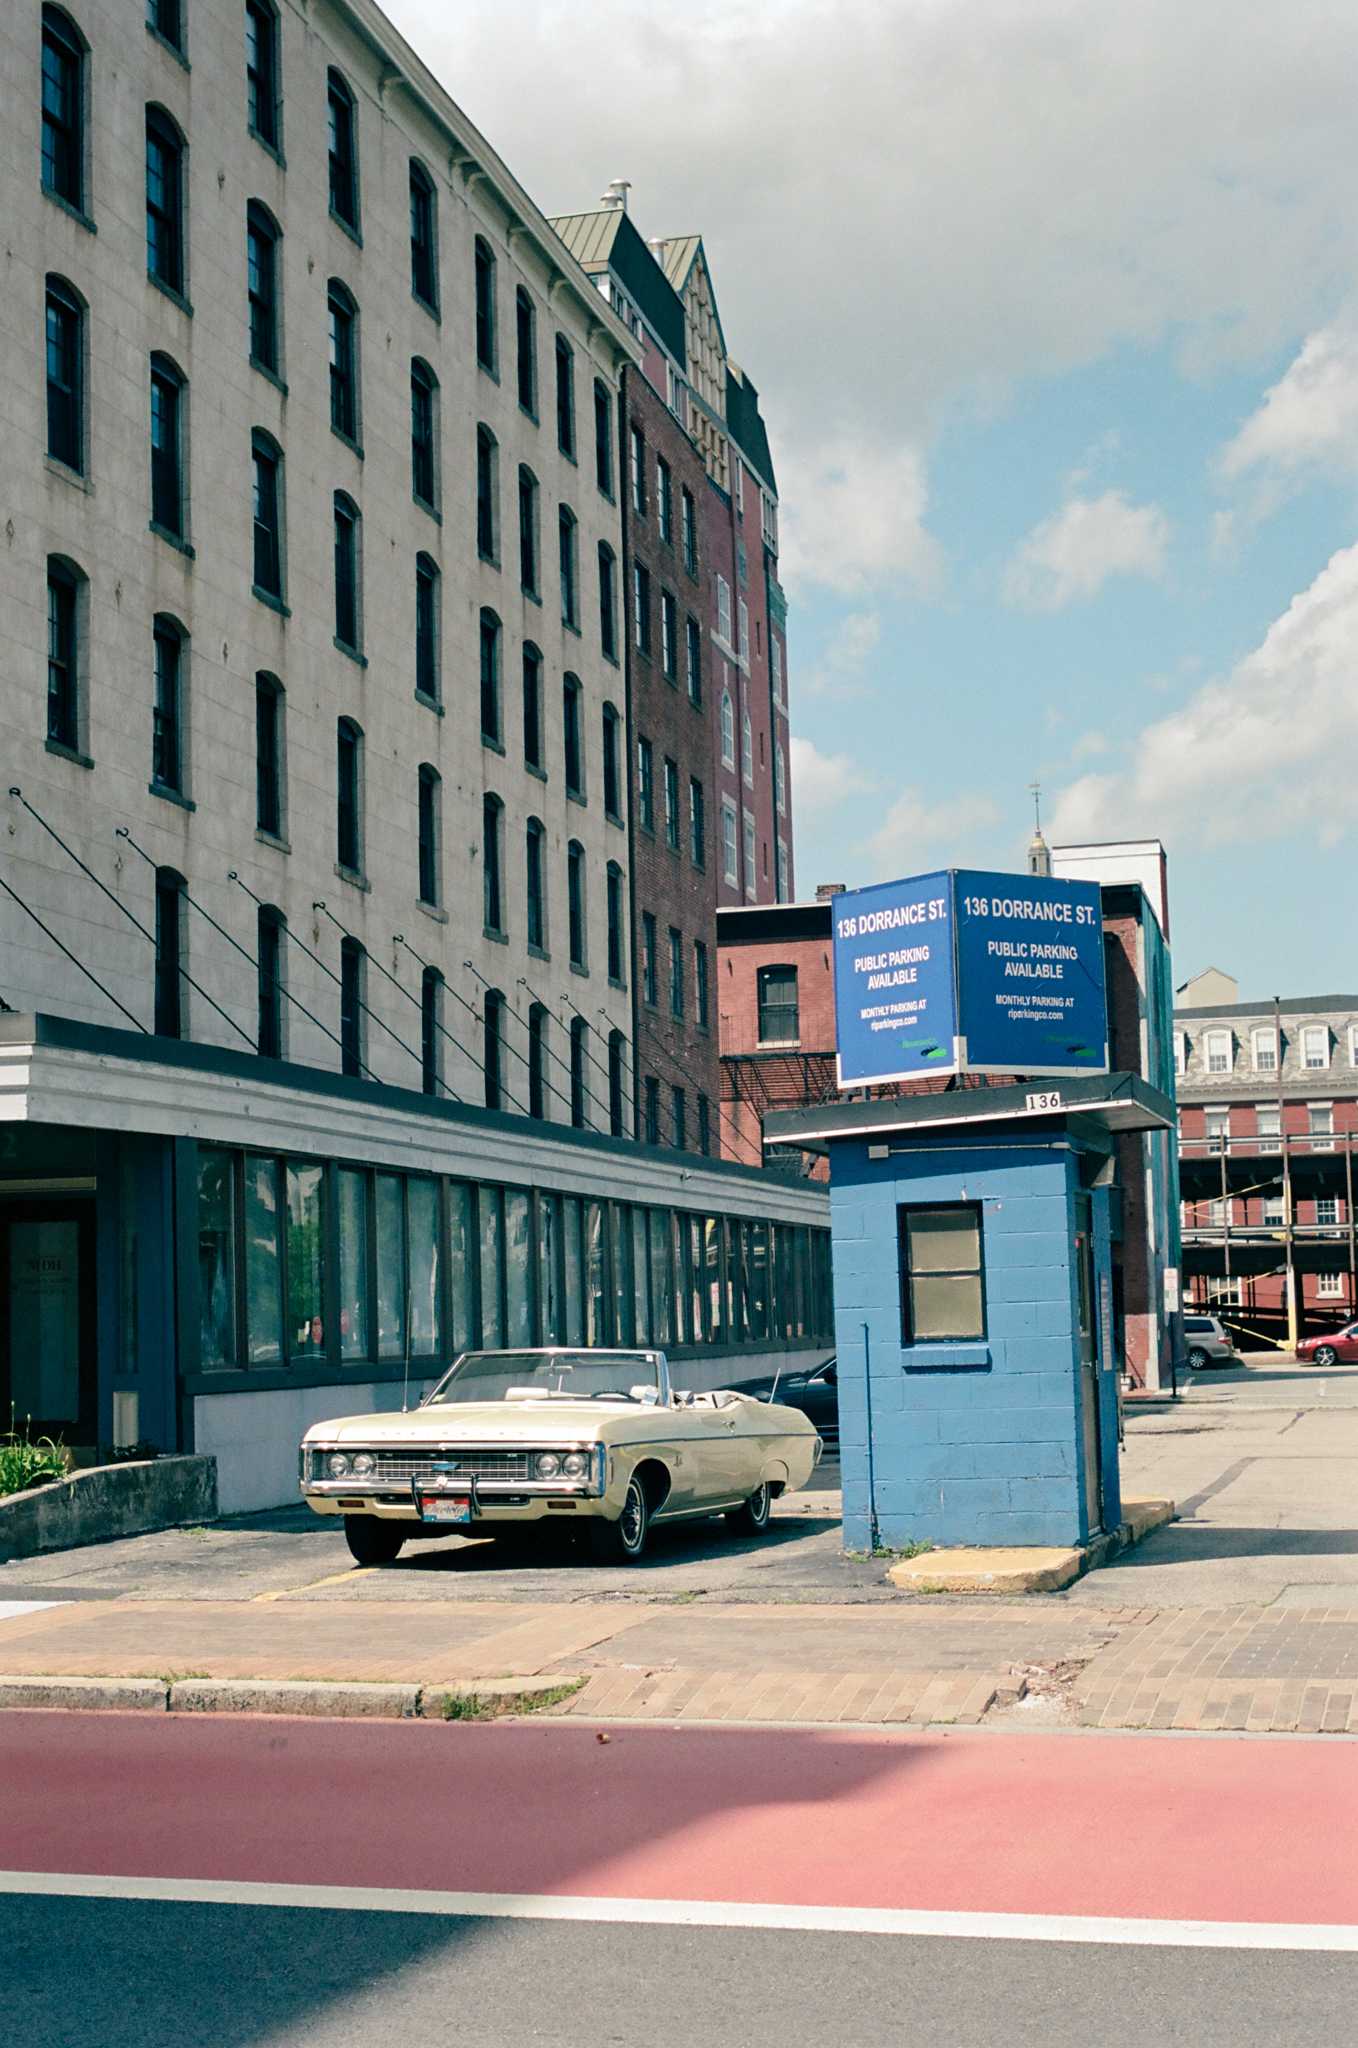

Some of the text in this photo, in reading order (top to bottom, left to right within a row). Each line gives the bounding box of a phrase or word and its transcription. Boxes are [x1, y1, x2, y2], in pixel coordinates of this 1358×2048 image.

[837, 899, 947, 938] 136 DORRANCE ST.
[964, 897, 1096, 925] 136 DORRANCE ST.
[855, 945, 930, 973] PUBLIC PARKING
[987, 941, 1078, 960] PUBLIC PARKING
[867, 968, 917, 990] AVAILABLE
[1004, 961, 1064, 979] AVAILABLE
[860, 999, 927, 1019] MONTHLY PARKING AT
[995, 994, 1075, 1008] MONTHLY PARKING AT
[1008, 1008, 1064, 1021] riparkingco.com
[1029, 1093, 1059, 1110] 136
